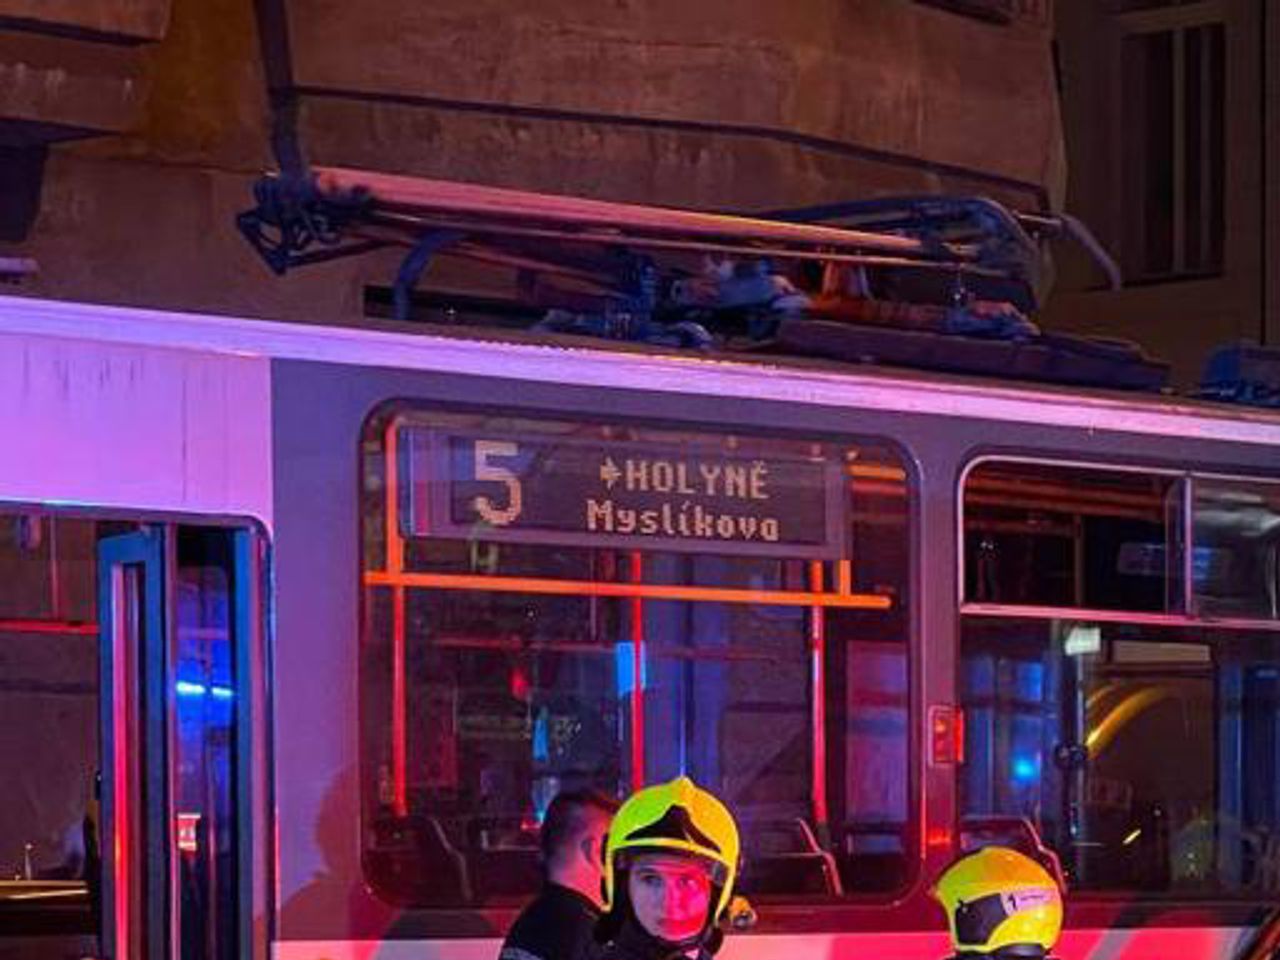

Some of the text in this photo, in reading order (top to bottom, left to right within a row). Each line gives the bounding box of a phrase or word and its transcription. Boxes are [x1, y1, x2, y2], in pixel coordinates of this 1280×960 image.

[474, 439, 522, 526] 5
[625, 459, 771, 499] HOLYNĚ
[586, 499, 780, 542] Myslíkova
